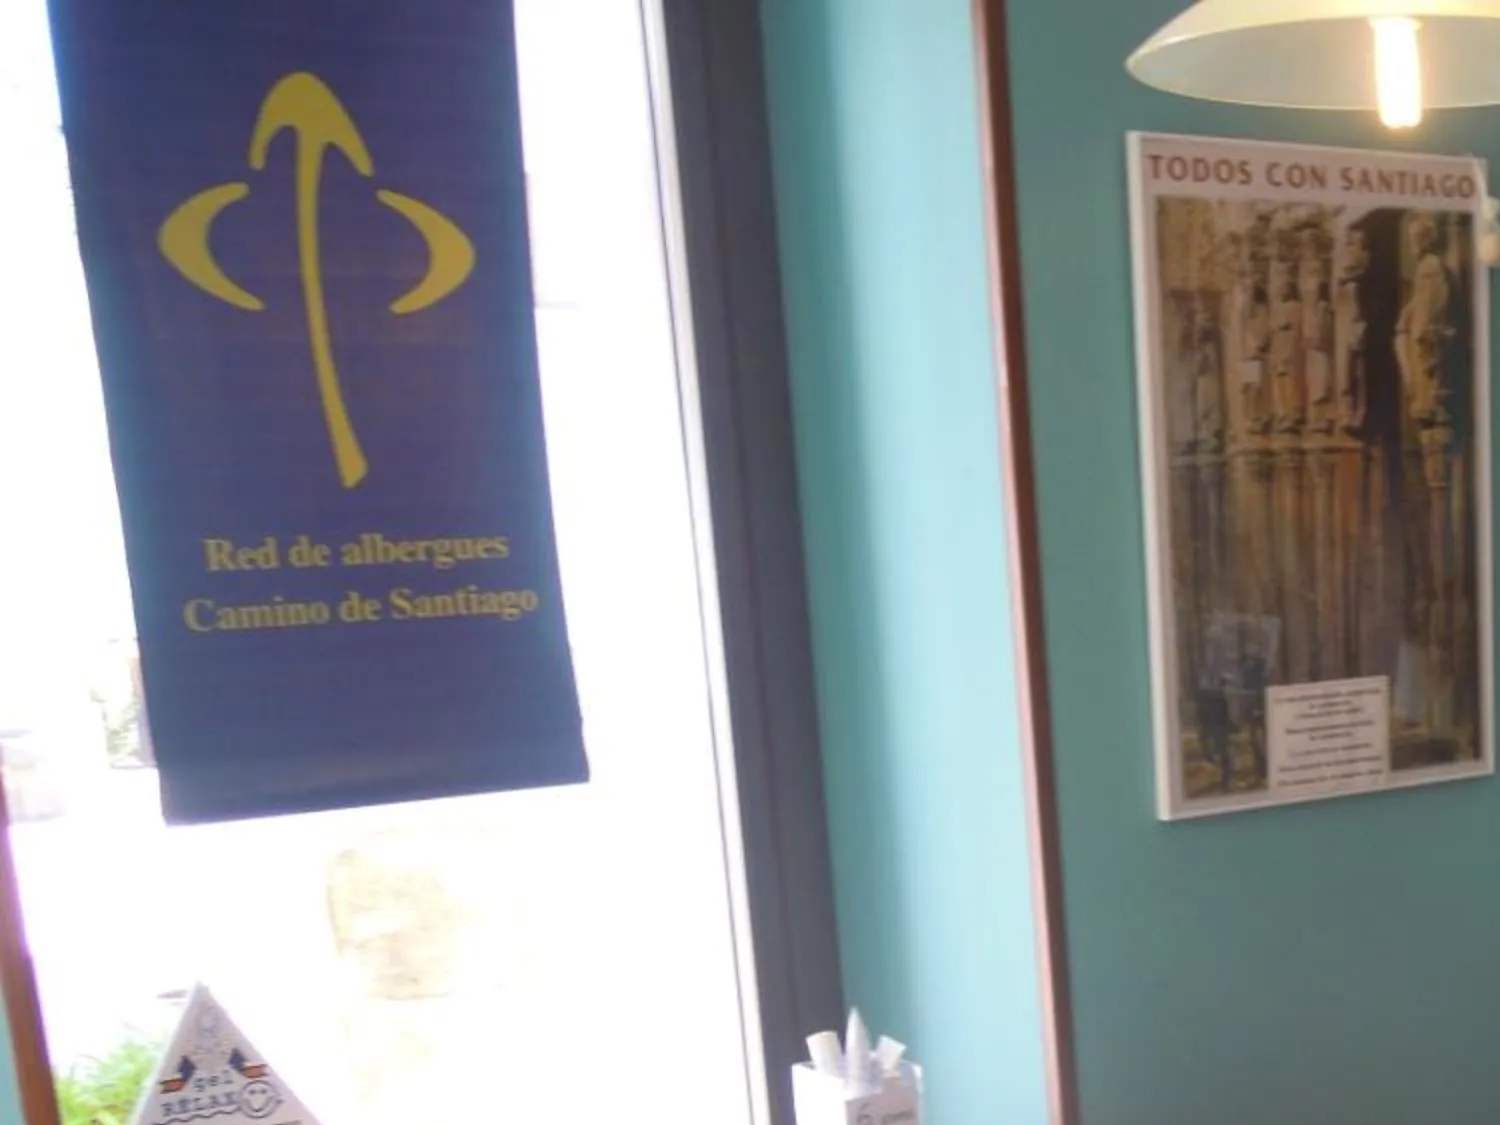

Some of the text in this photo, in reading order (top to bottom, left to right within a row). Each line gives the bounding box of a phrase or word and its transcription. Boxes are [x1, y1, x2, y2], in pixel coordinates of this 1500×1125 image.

[1149, 154, 1476, 198] TODOS CON SANTIAGO
[203, 533, 509, 571] Red de albergues
[183, 585, 539, 632] Camino de Santiago
